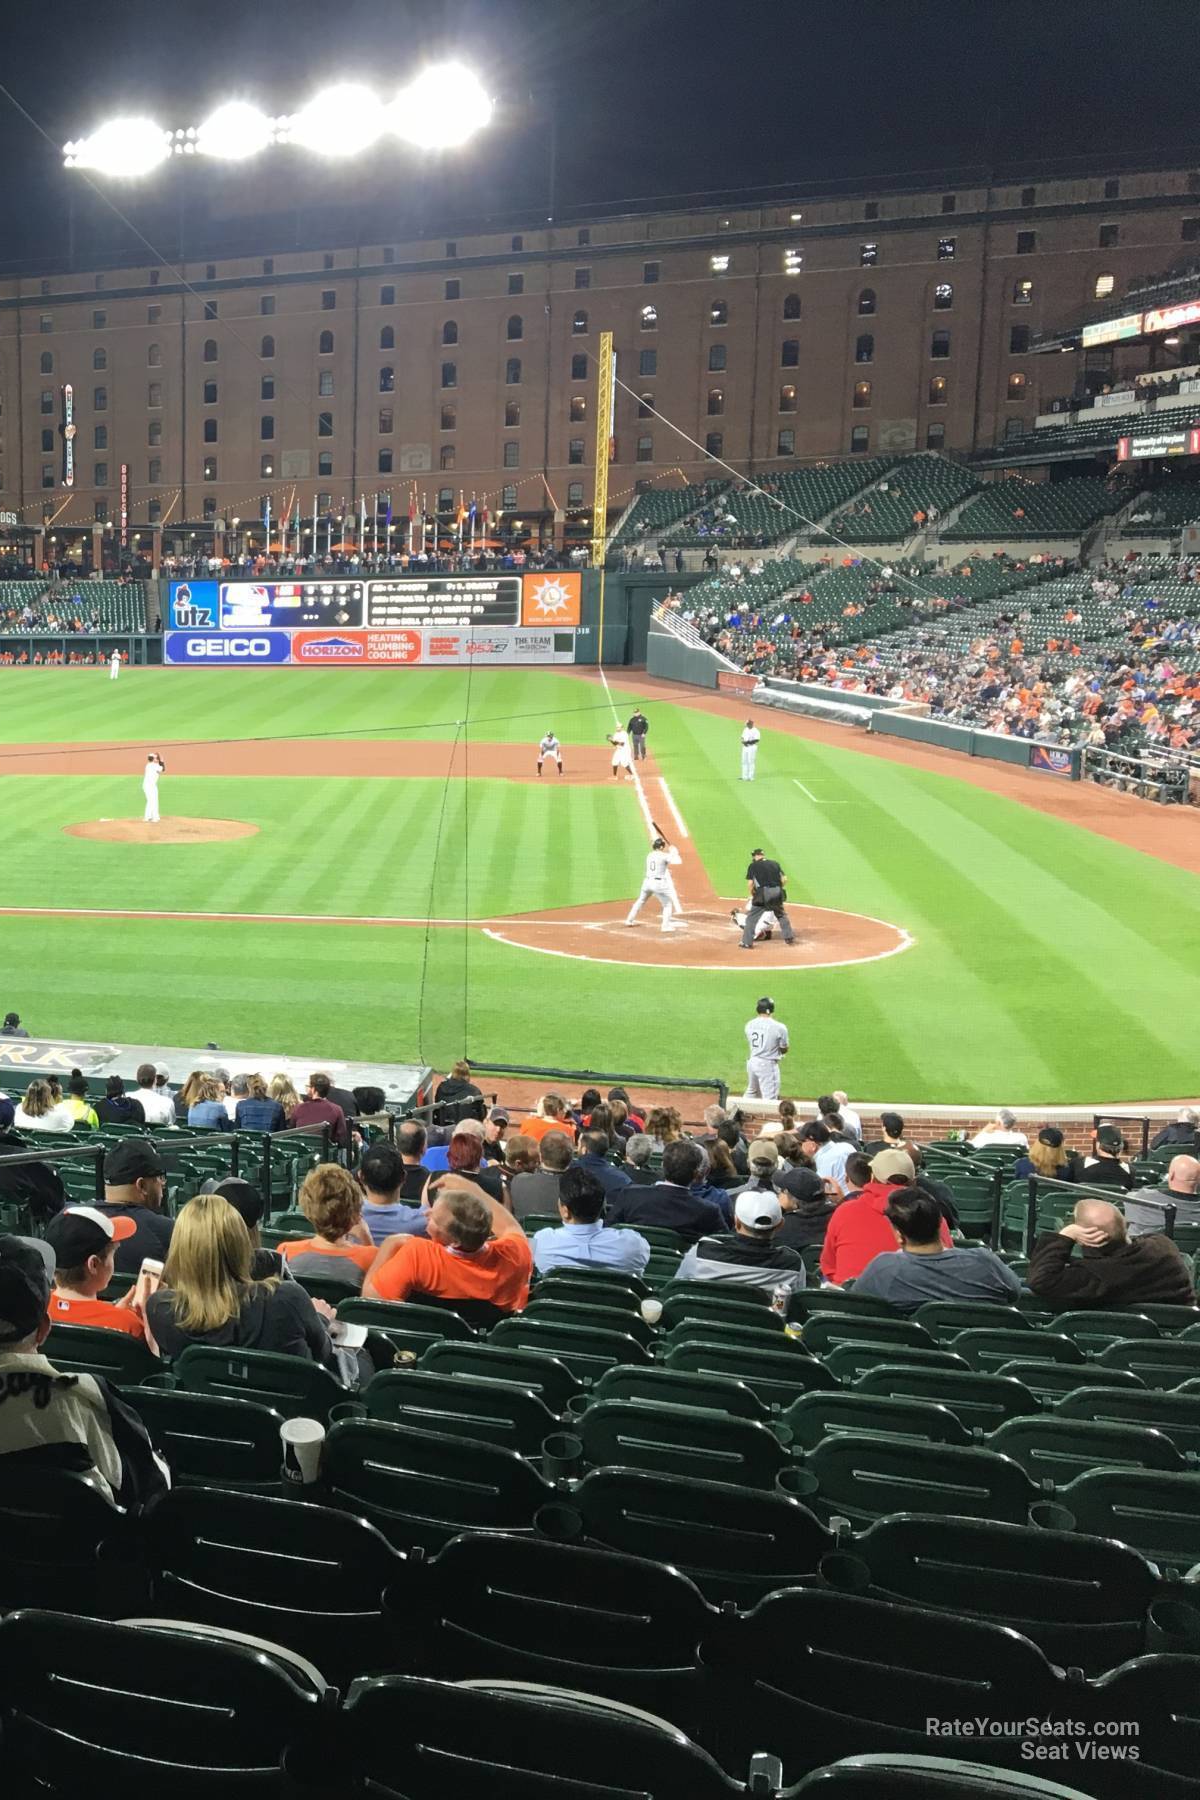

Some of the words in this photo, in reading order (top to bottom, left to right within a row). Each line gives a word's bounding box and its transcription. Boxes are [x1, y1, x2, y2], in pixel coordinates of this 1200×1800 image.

[187, 639, 270, 656] GEICO
[367, 651, 408, 659] COOLING
[751, 1032, 764, 1048] 21
